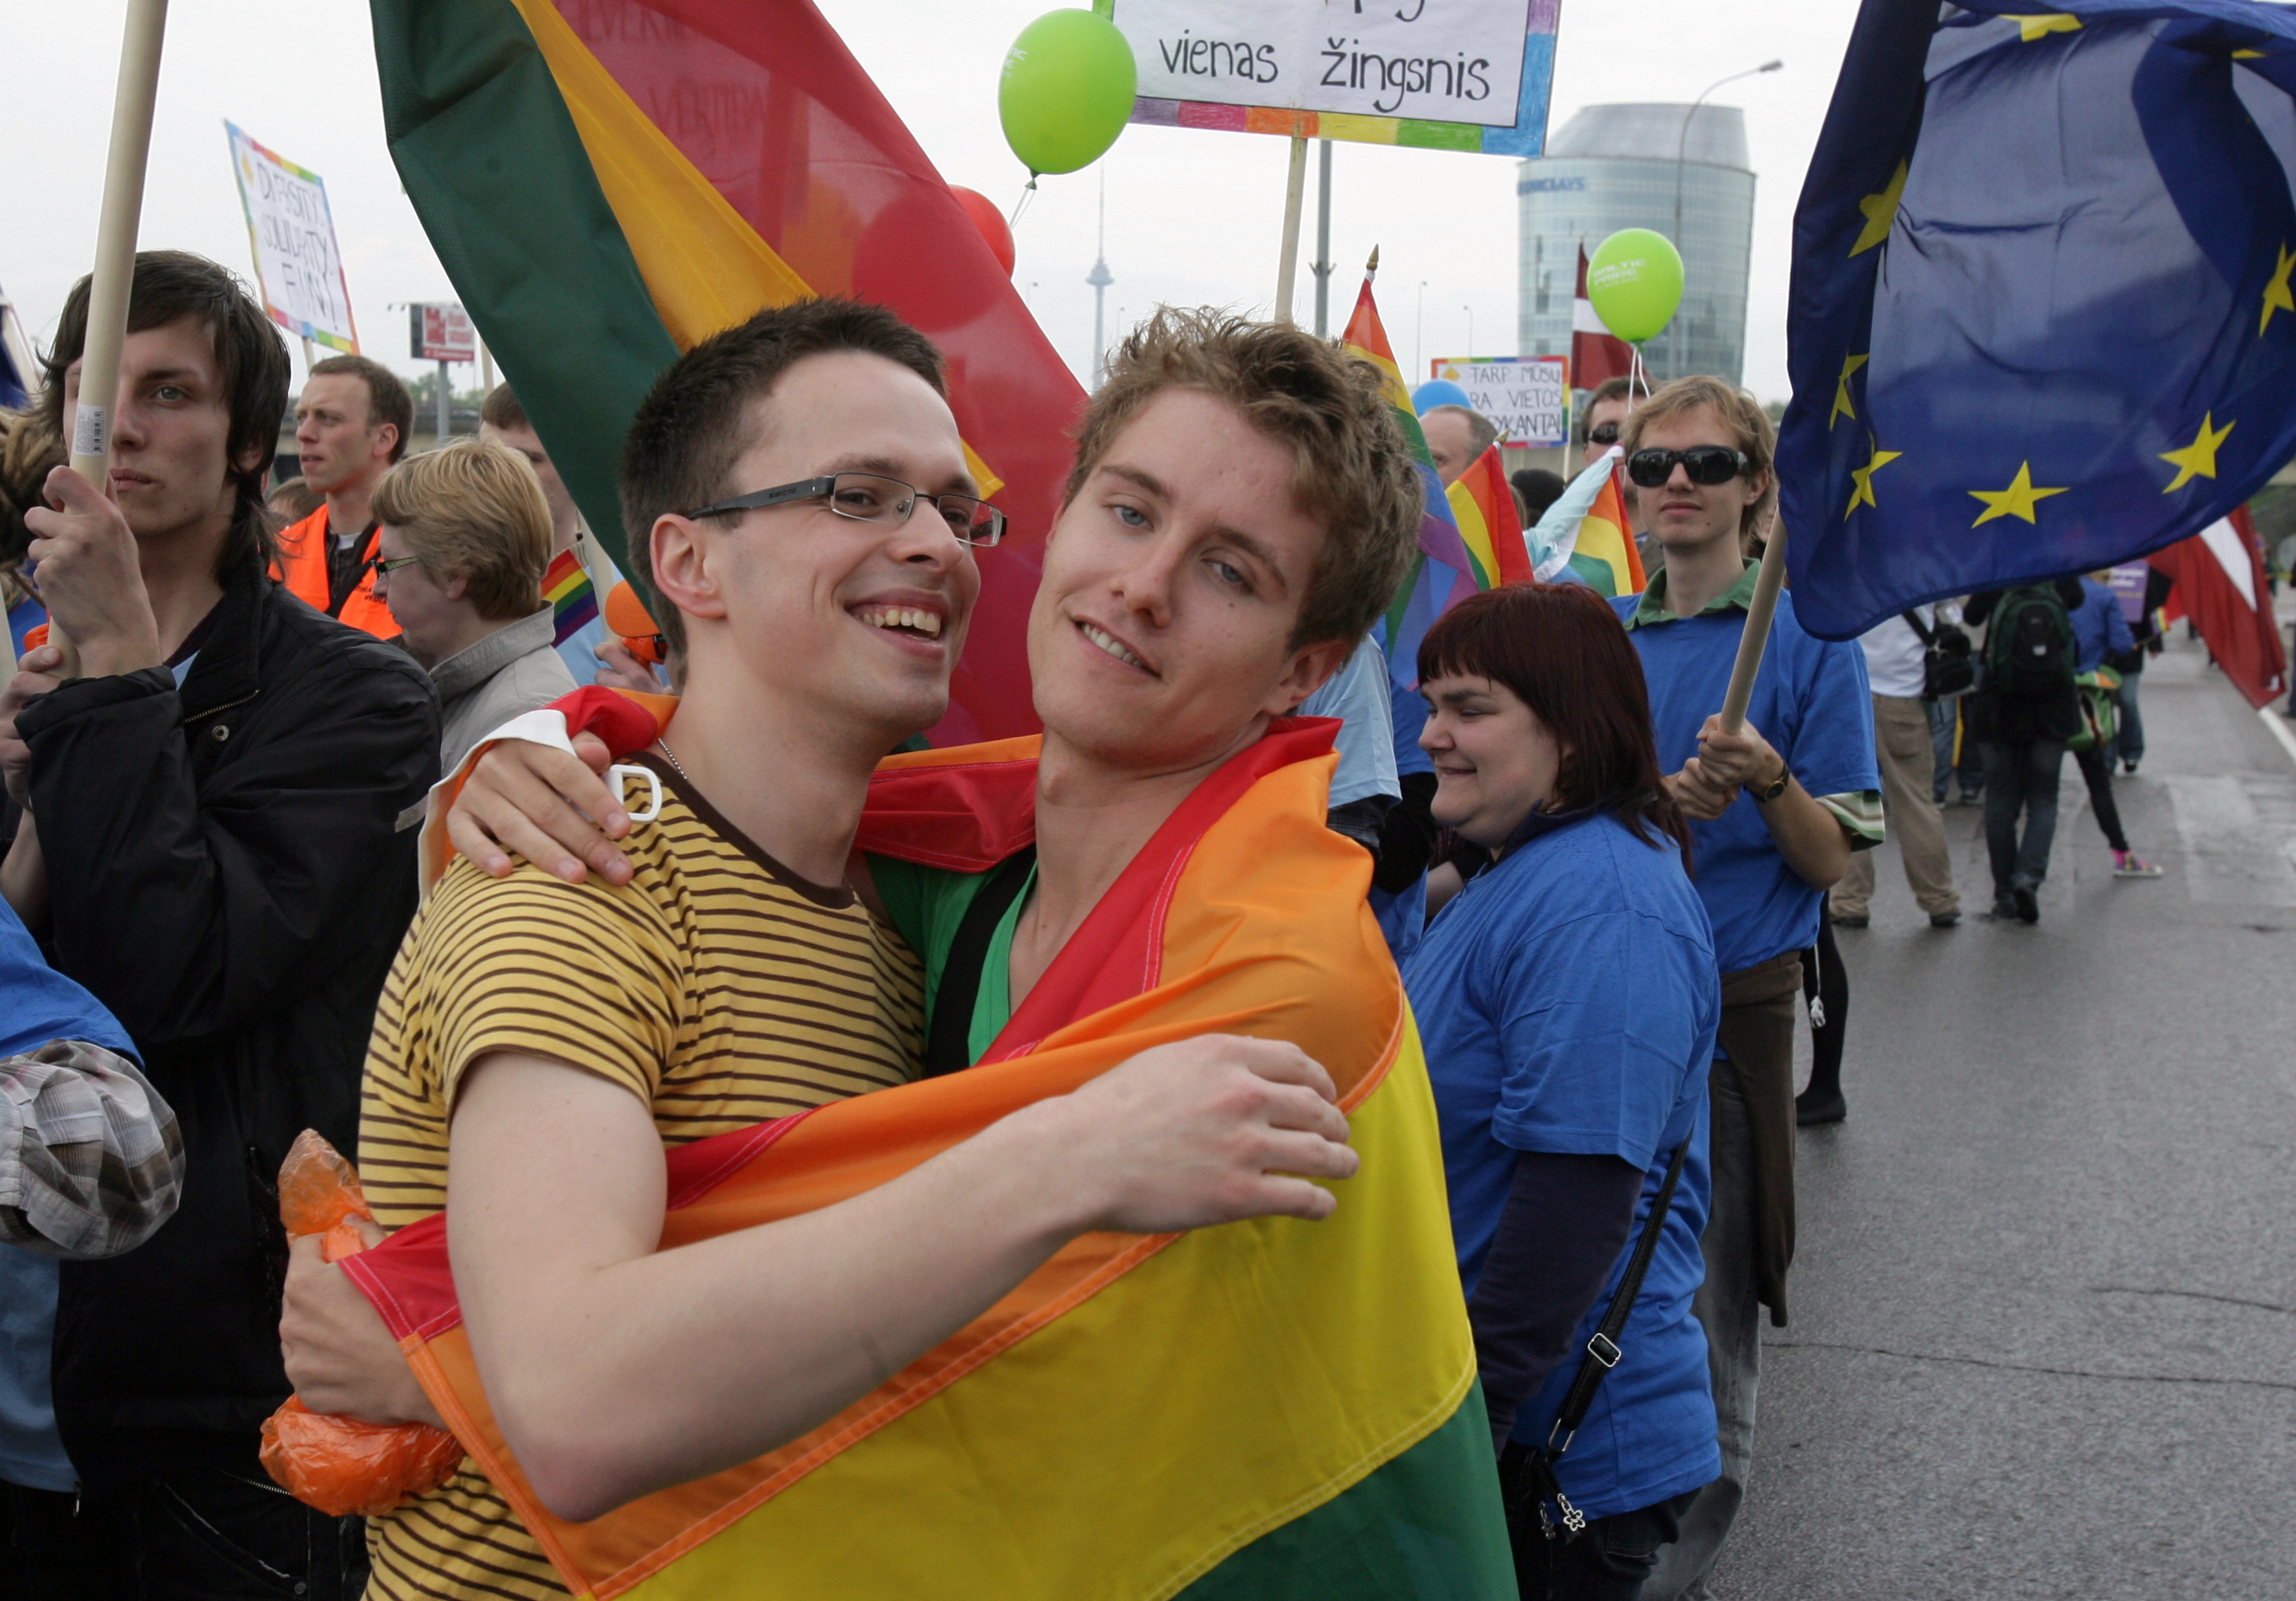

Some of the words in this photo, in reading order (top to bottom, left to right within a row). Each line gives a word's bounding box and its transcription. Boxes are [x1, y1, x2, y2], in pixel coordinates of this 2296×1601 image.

[1159, 29, 1279, 84] vienas
[1320, 36, 1491, 114] žingsnis
[1470, 366, 1510, 384] TARP
[1508, 388, 1563, 409] VIETOS
